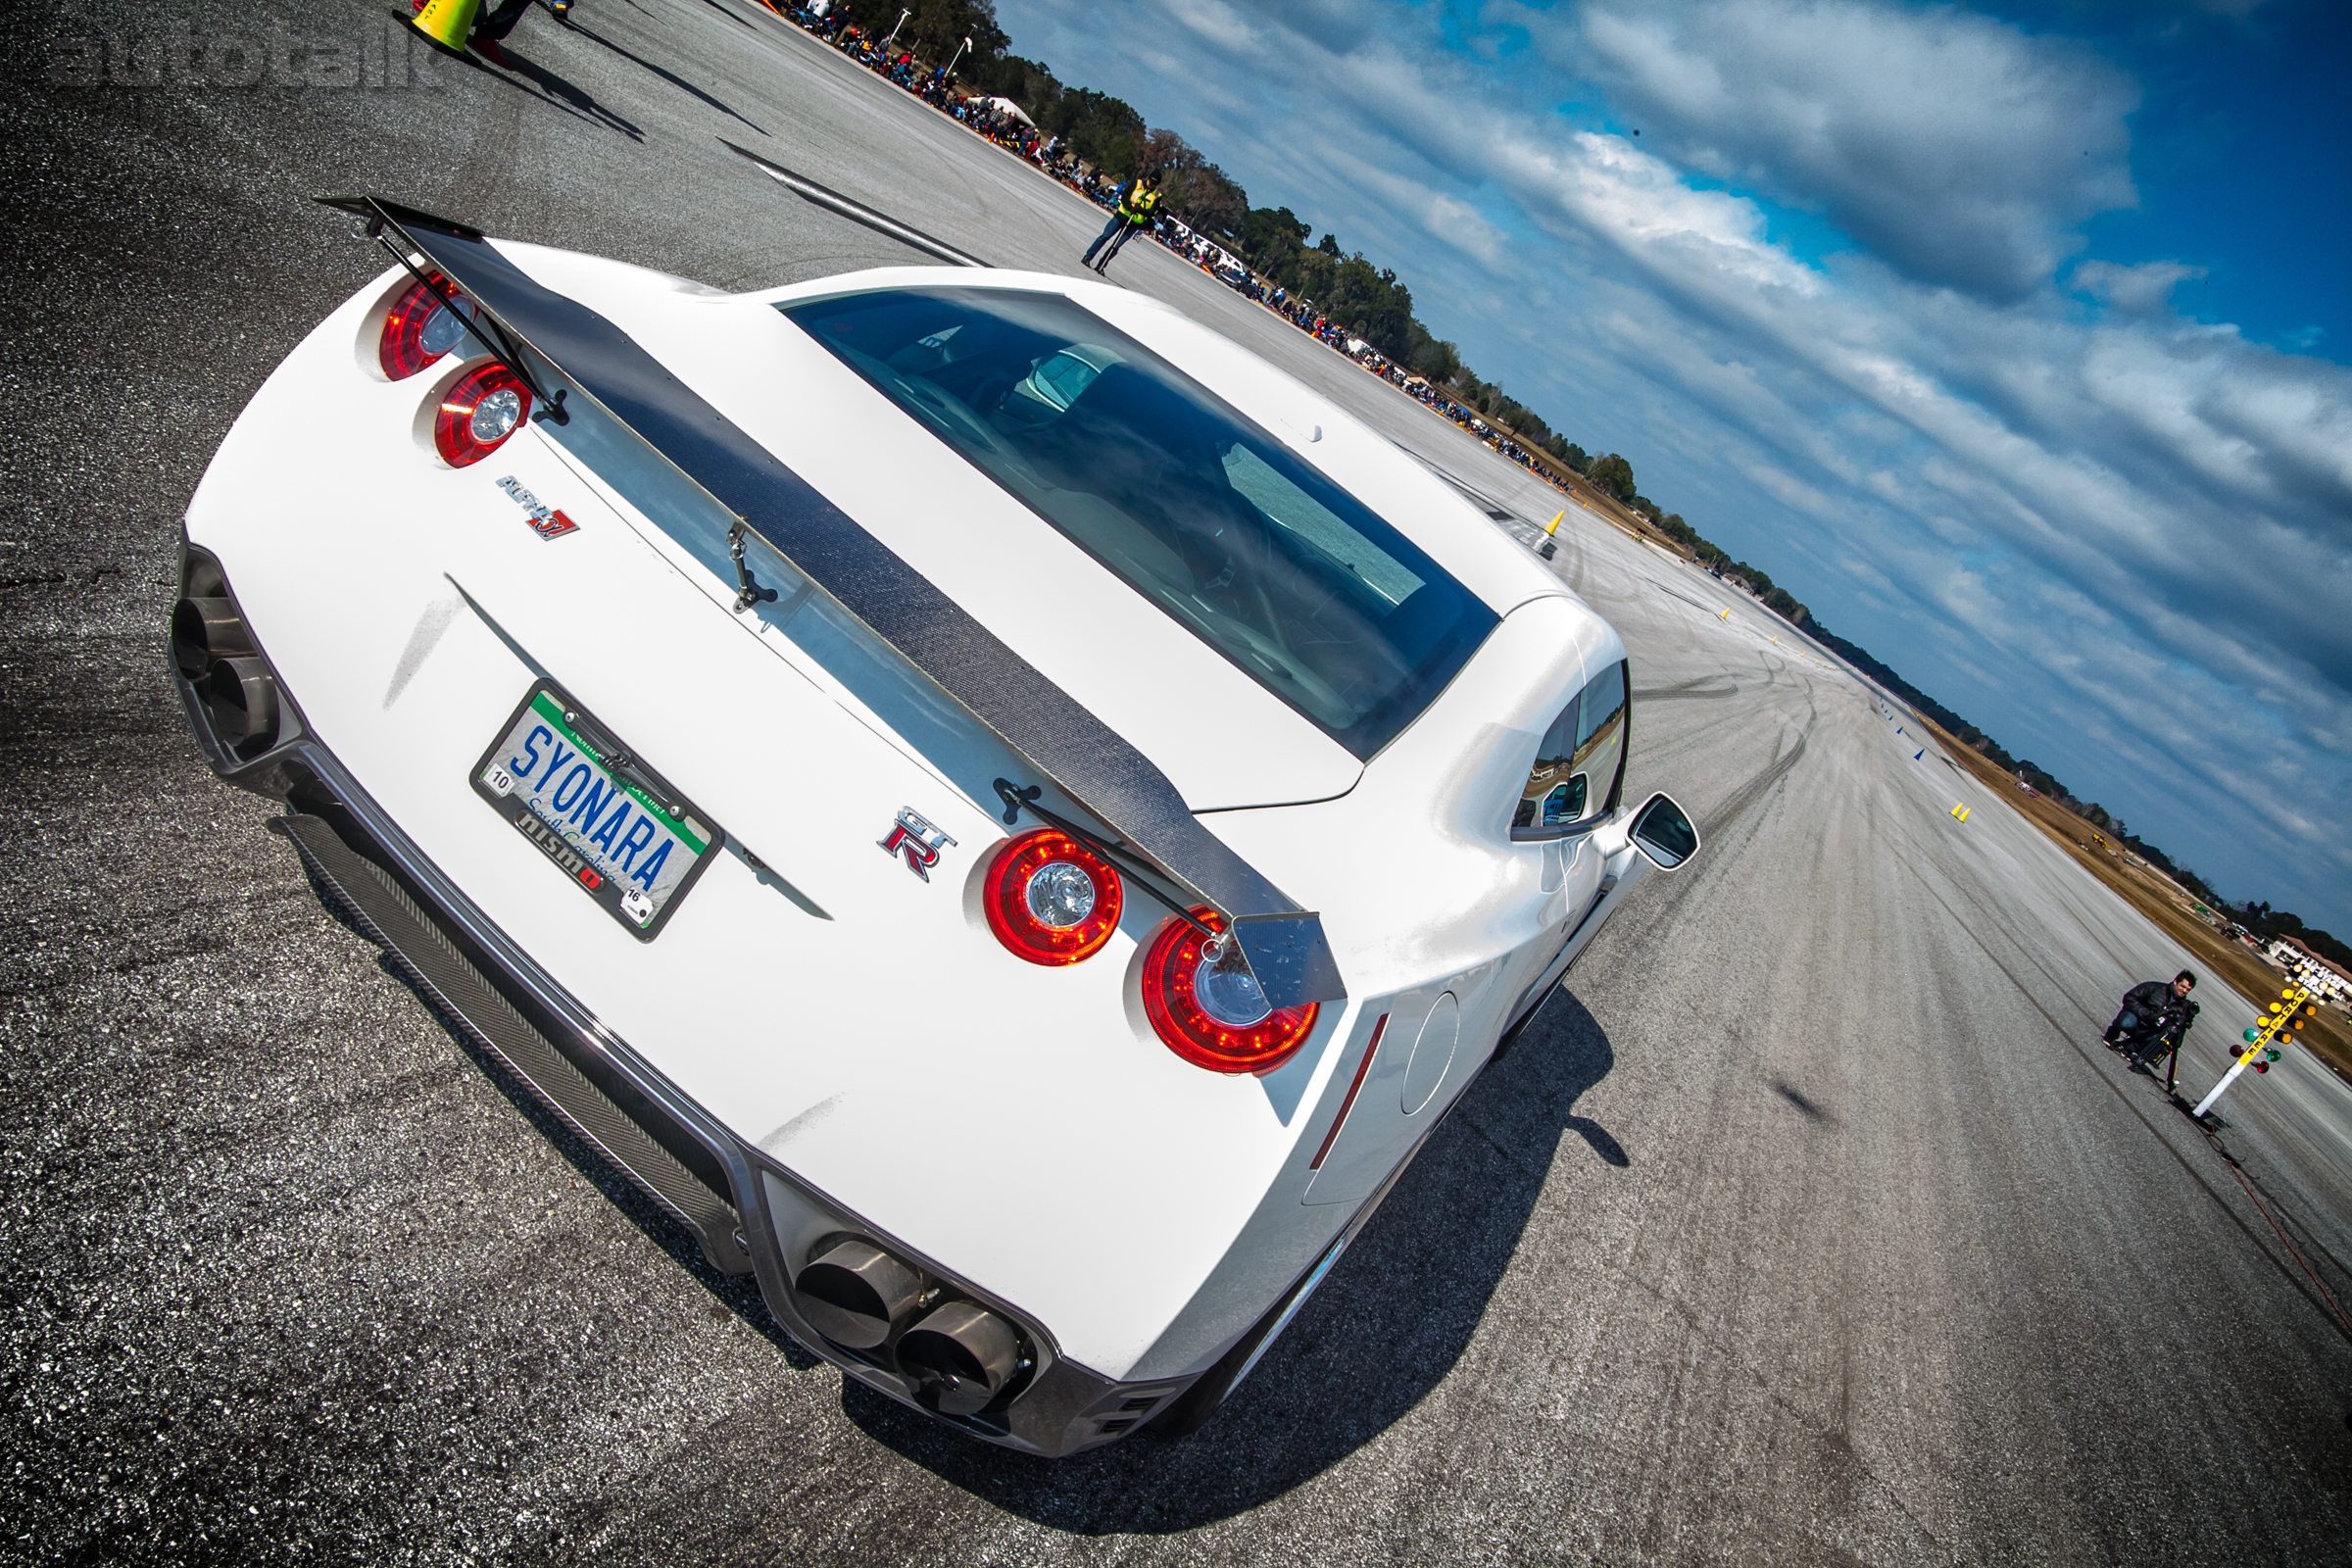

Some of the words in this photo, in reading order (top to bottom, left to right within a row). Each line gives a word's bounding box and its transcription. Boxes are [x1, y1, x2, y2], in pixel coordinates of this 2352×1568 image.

[492, 770, 510, 789] 10
[510, 724, 675, 894] SYONARA
[627, 888, 641, 903] 16
[2297, 975, 2325, 997] STAGE
